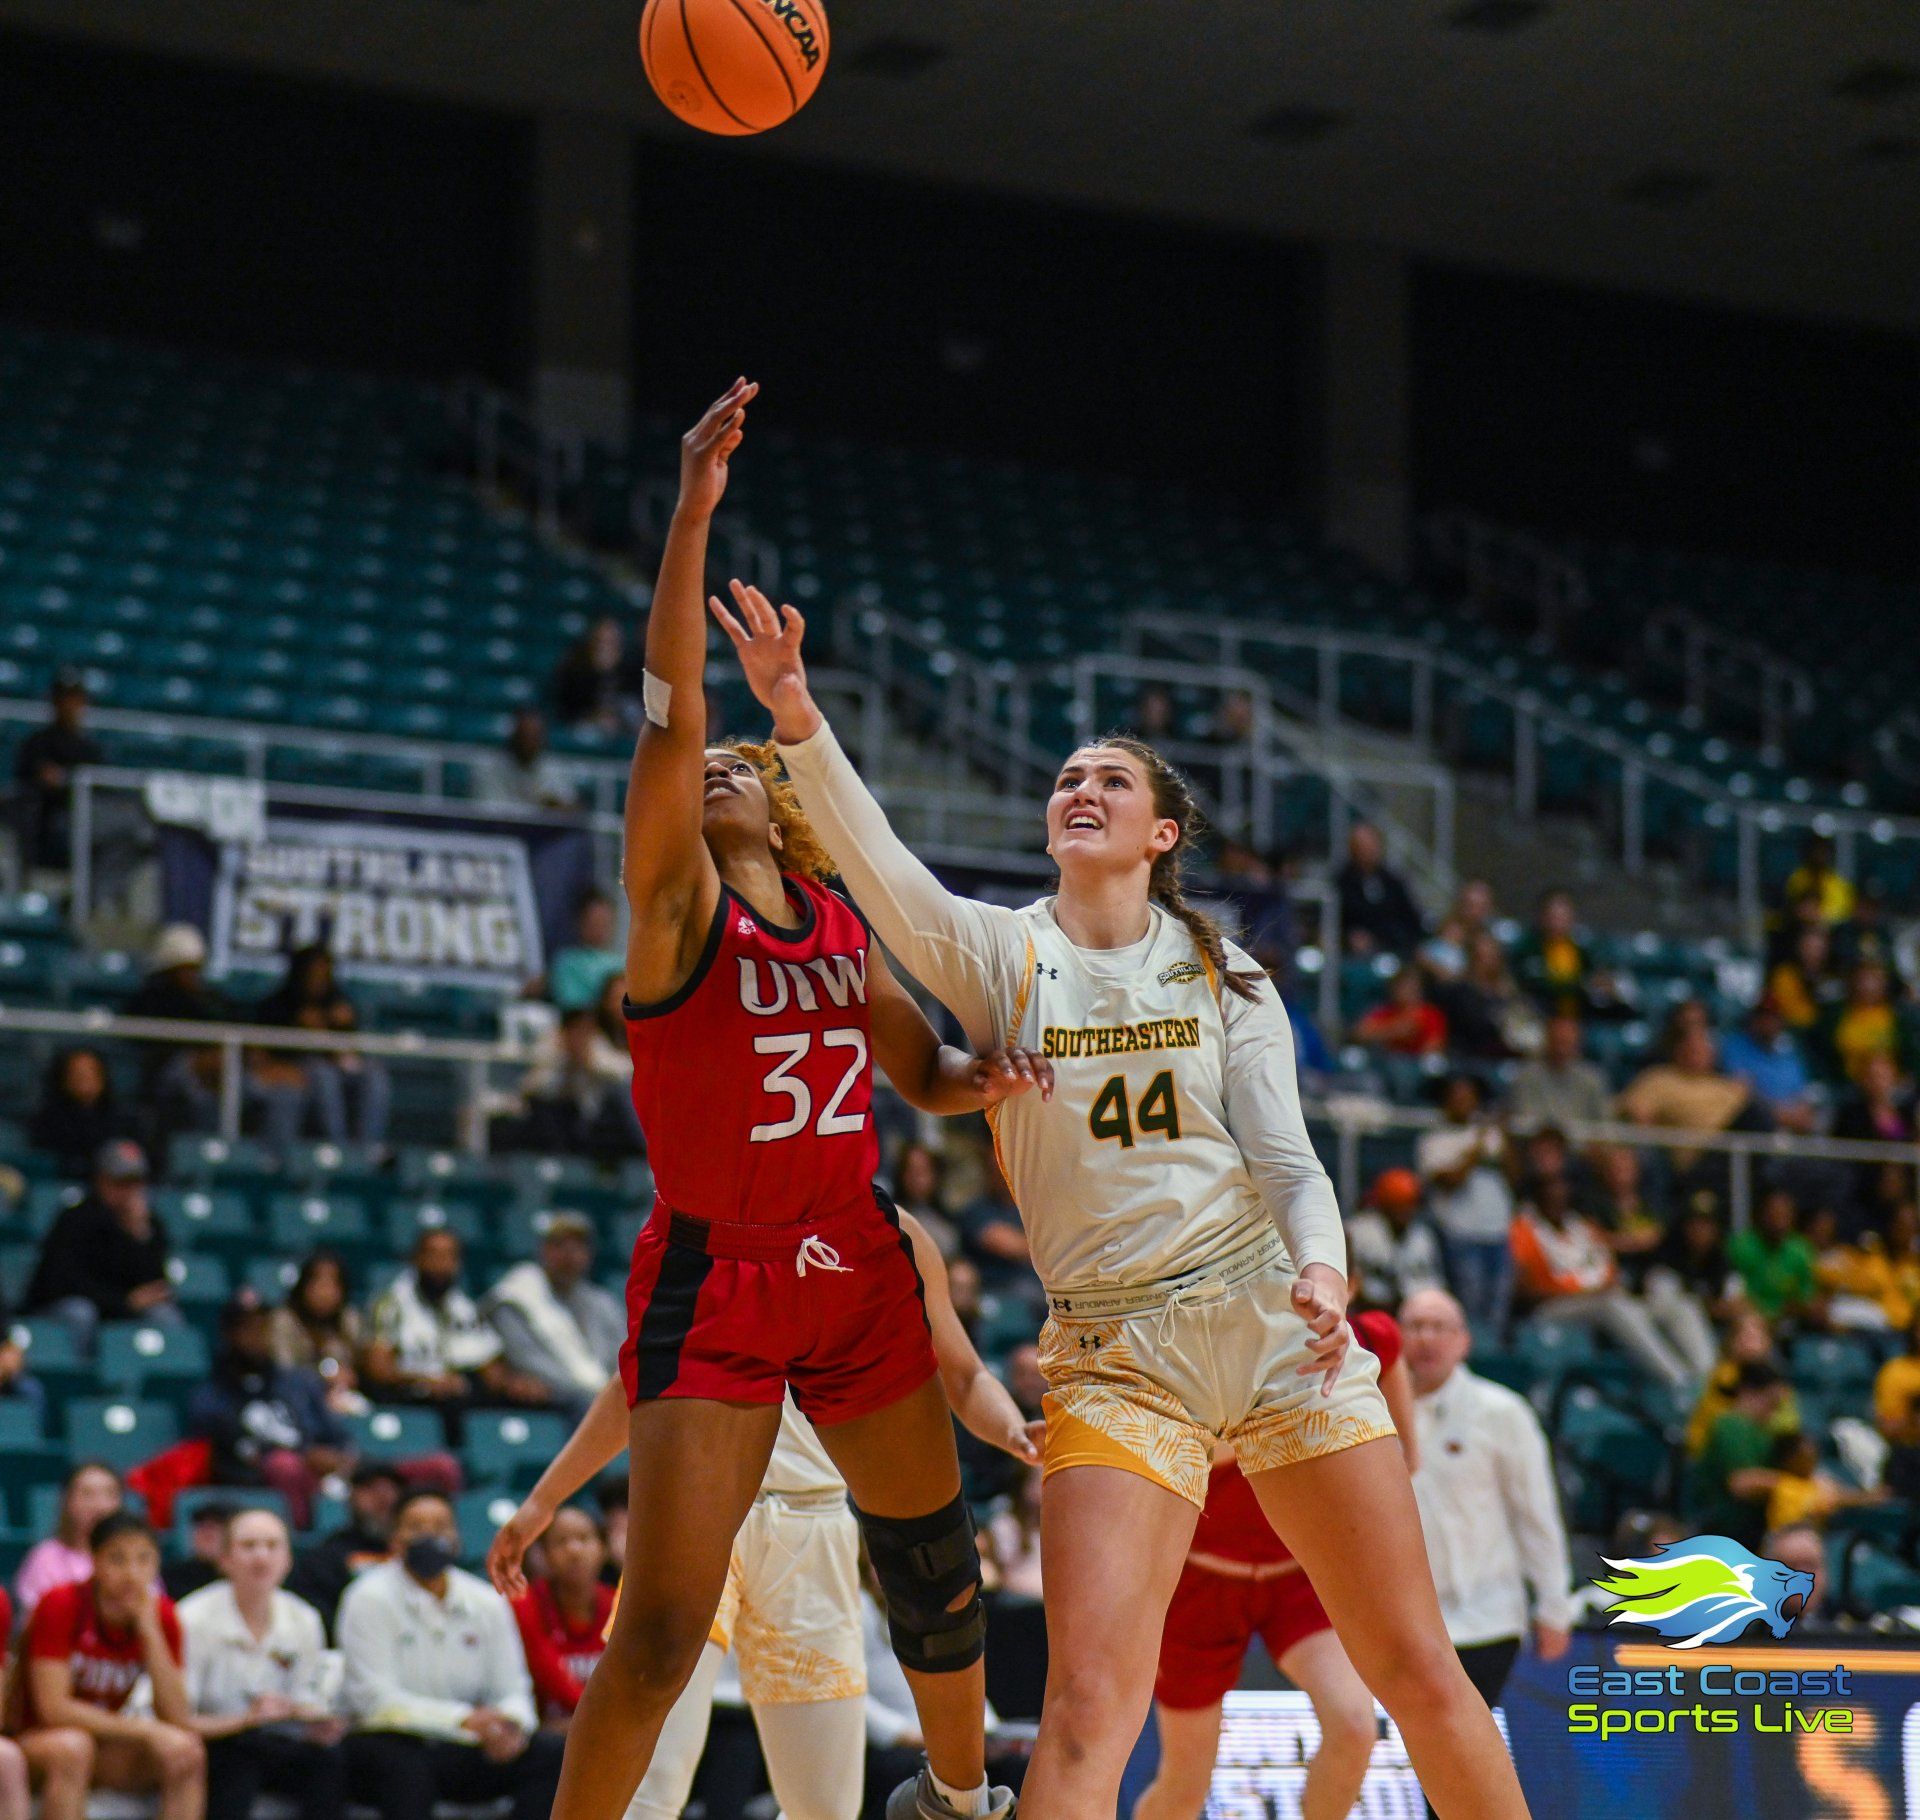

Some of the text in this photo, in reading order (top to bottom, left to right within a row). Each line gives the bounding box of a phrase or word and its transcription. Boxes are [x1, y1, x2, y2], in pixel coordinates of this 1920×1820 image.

[234, 882, 524, 970] STRONG
[735, 948, 867, 1017] UIW
[1043, 1016, 1201, 1059] SOUTHEASTERN
[749, 1027, 868, 1142] 32
[1088, 1069, 1182, 1150] 44
